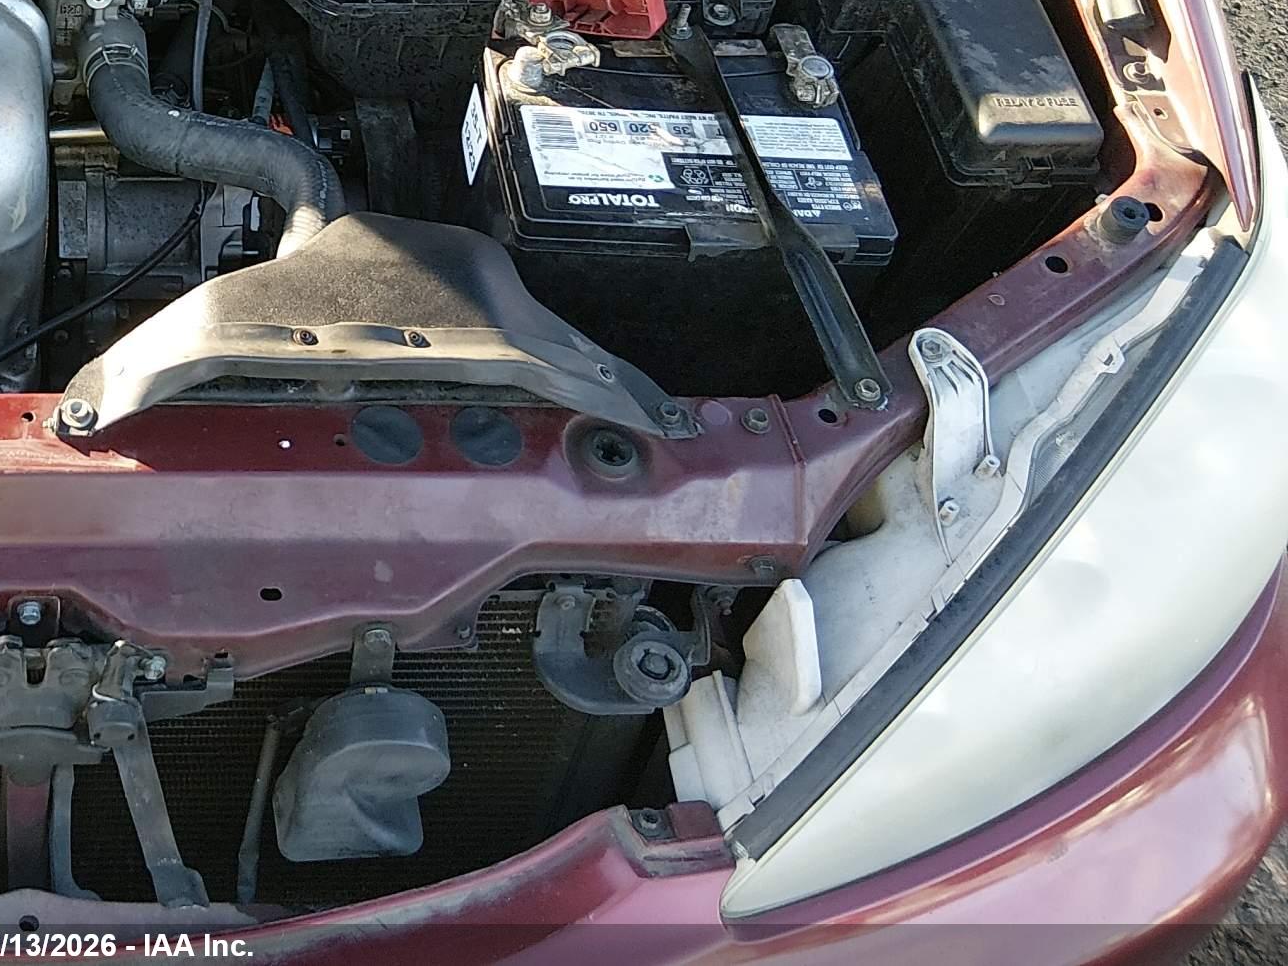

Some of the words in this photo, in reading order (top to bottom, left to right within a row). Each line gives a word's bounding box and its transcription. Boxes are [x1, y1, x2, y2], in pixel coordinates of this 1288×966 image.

[994, 96, 1032, 107] RELAY
[1045, 97, 1079, 107] FUSE
[589, 121, 619, 132] 650
[672, 125, 690, 134] 35
[568, 194, 661, 207] TOTALPRO
